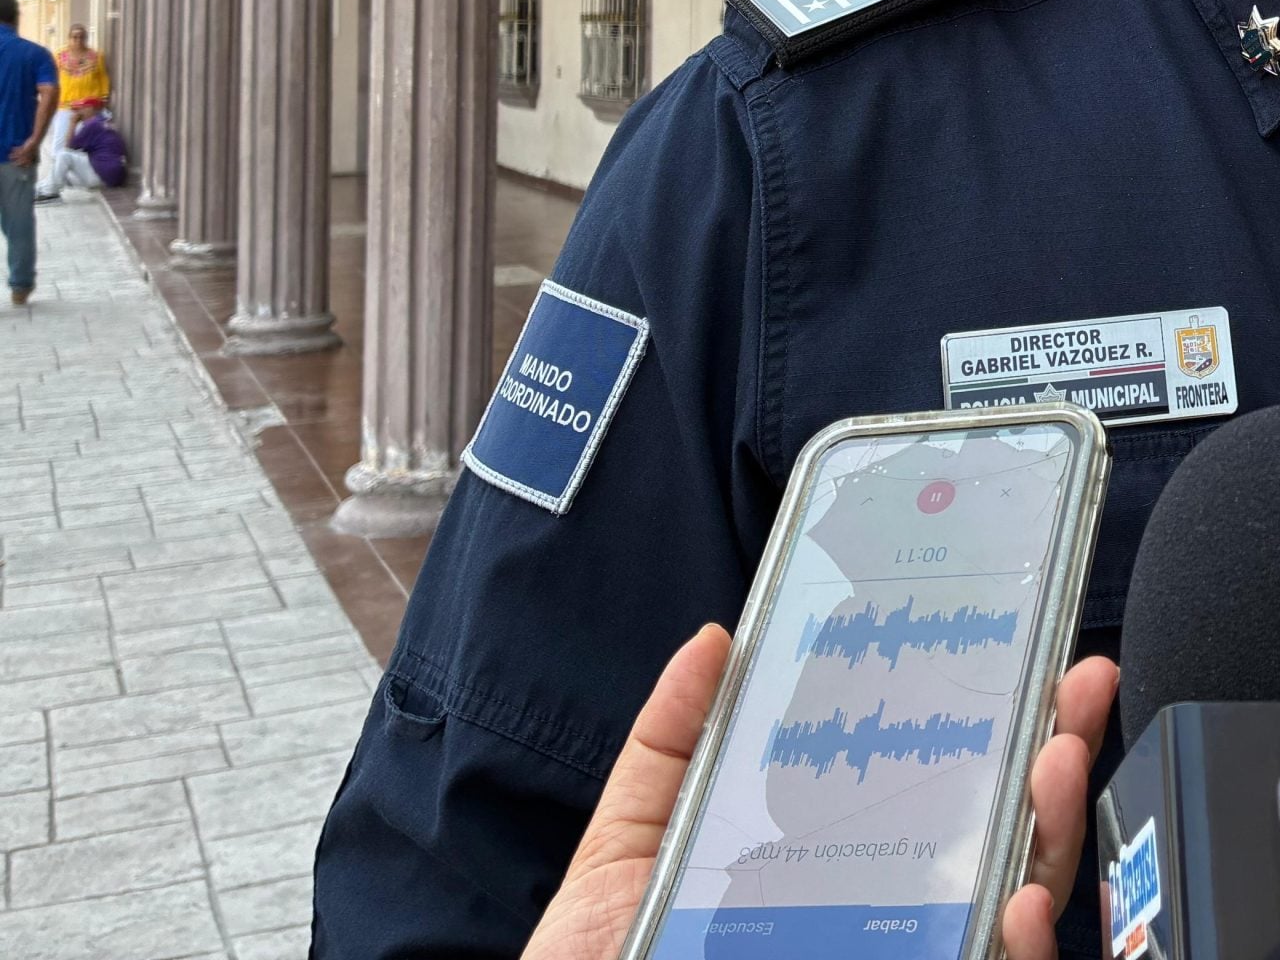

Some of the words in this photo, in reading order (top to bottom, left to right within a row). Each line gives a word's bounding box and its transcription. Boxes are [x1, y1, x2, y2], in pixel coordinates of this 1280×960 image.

[1010, 329, 1102, 353] DIRECTOR
[961, 354, 1041, 376] GABRIEL
[1045, 344, 1130, 367] VAZQUEZ
[1136, 342, 1153, 358] R.
[519, 353, 573, 392] MANDO
[500, 375, 591, 433] COORDINADO
[1071, 382, 1160, 410] MUNICIPAL
[1175, 381, 1229, 409] FRONTERA
[894, 547, 948, 564] 00:11
[815, 838, 908, 862] grabación
[912, 841, 938, 860] Mi
[702, 922, 775, 936] Escuchar
[863, 919, 918, 934] Grabar
